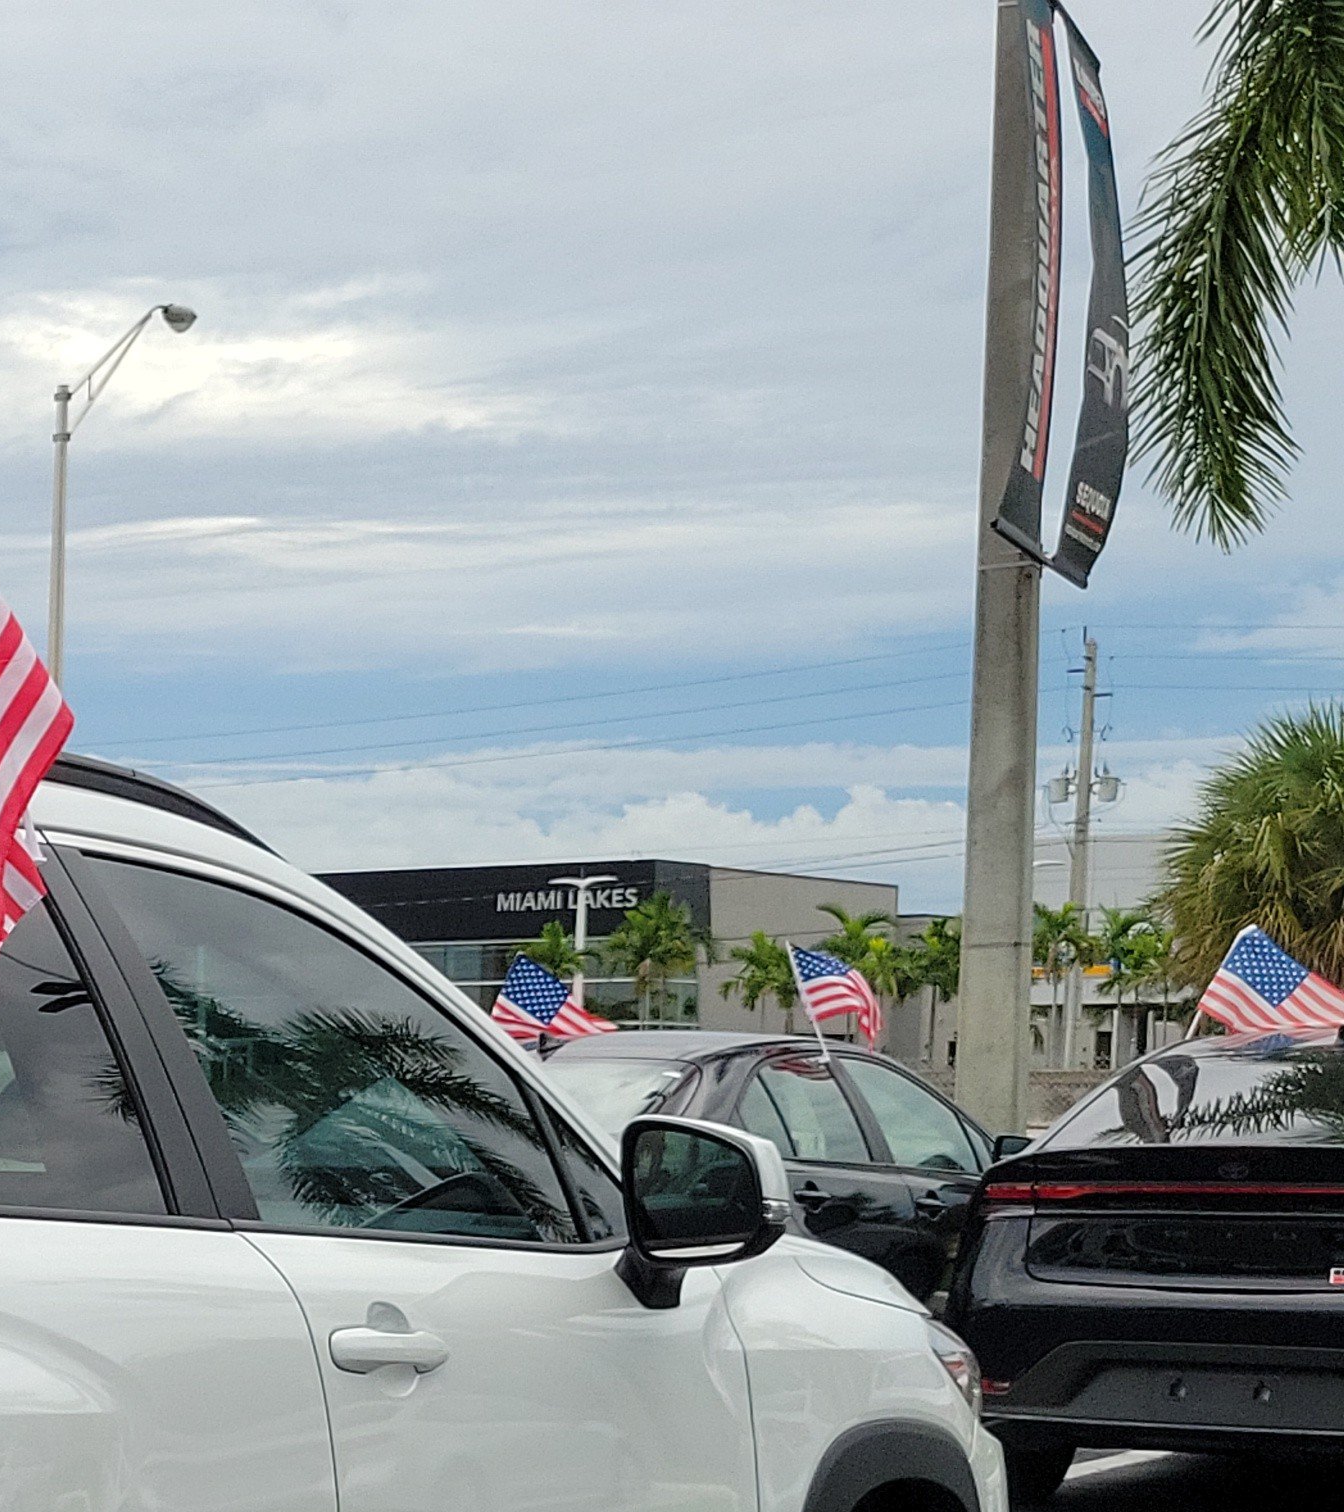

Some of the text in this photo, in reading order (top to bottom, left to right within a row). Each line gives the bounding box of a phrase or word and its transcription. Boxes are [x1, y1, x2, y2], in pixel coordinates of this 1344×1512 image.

[1020, 18, 1051, 473] HEADQUARTER
[496, 888, 639, 912] MIAMI LAKES
